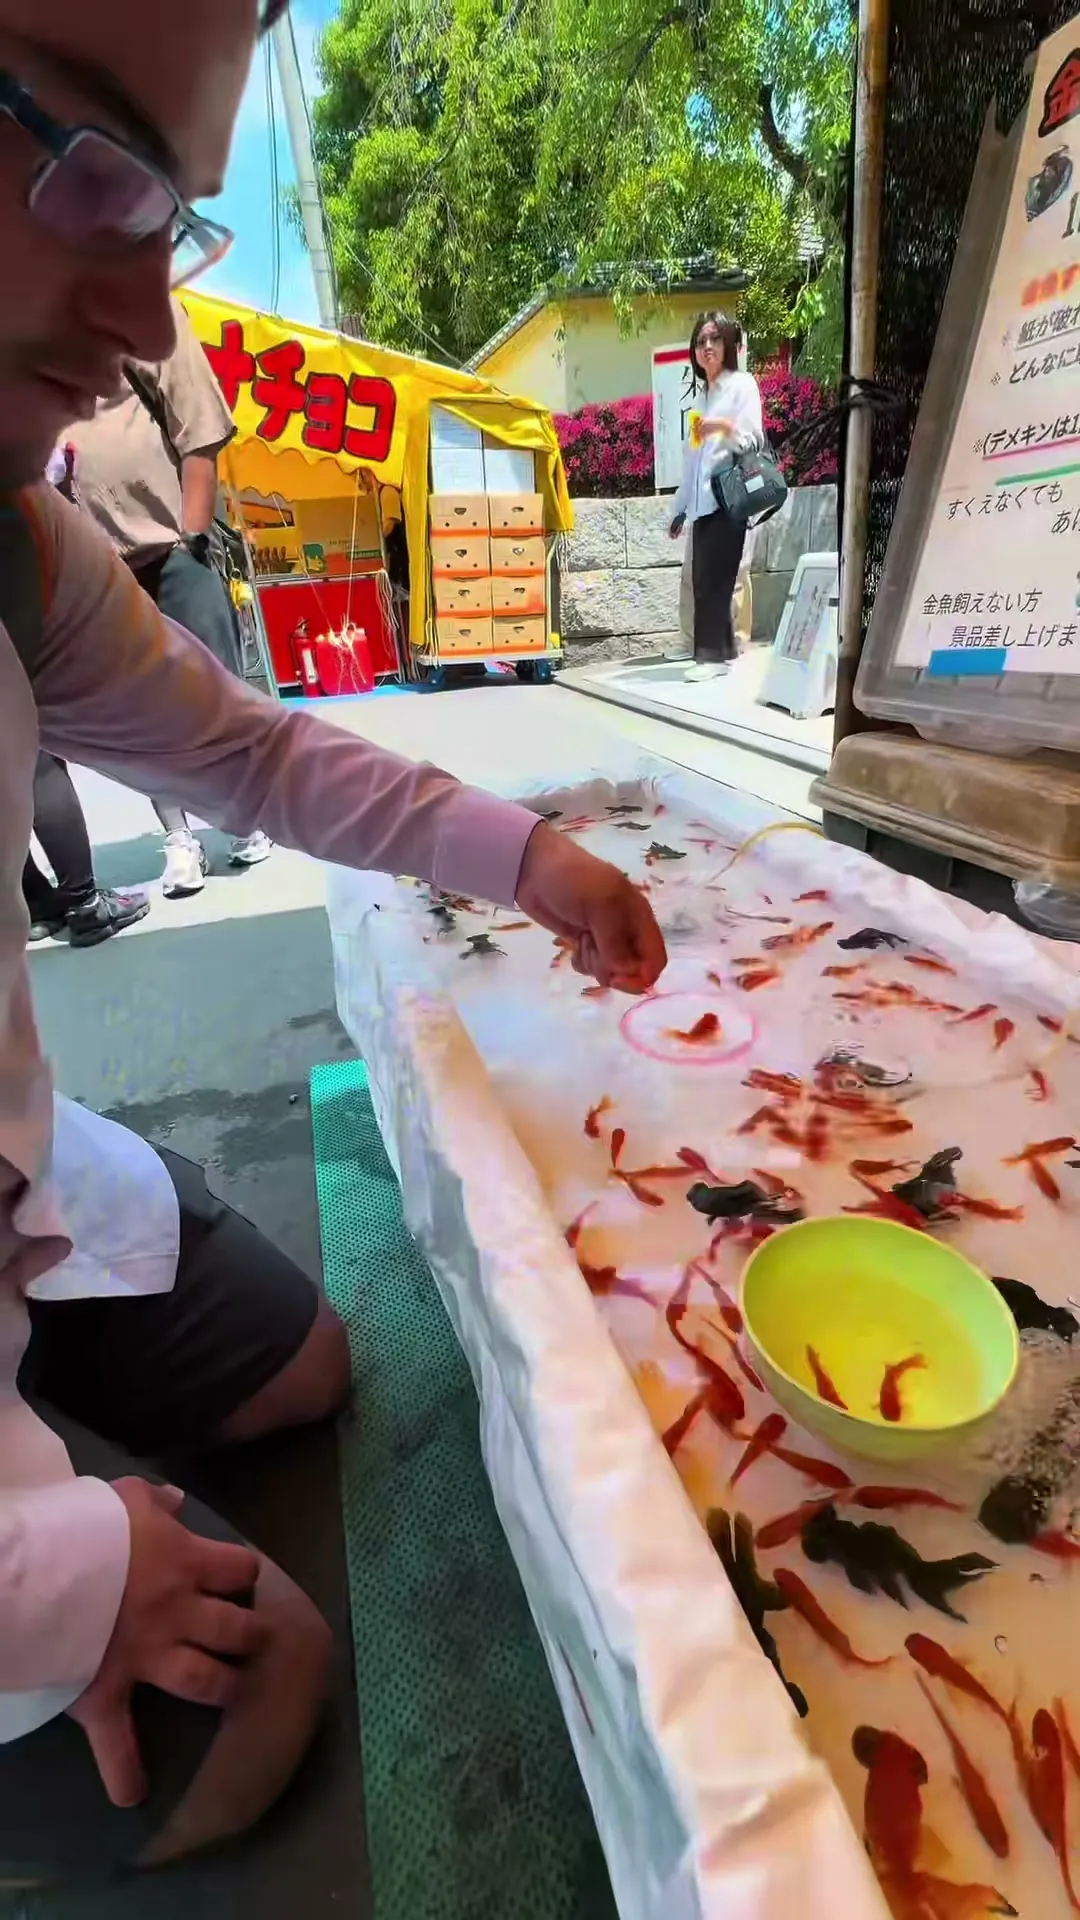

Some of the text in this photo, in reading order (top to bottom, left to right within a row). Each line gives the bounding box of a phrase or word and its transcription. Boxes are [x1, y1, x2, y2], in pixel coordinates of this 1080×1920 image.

[1008, 342, 1080, 384] どんなに
[973, 413, 1080, 455] ※(デメキンは1
[947, 480, 1064, 520] すくえなくても
[921, 587, 1043, 616] 金魚飼えない方
[948, 623, 1078, 648] 景品差し上げま
